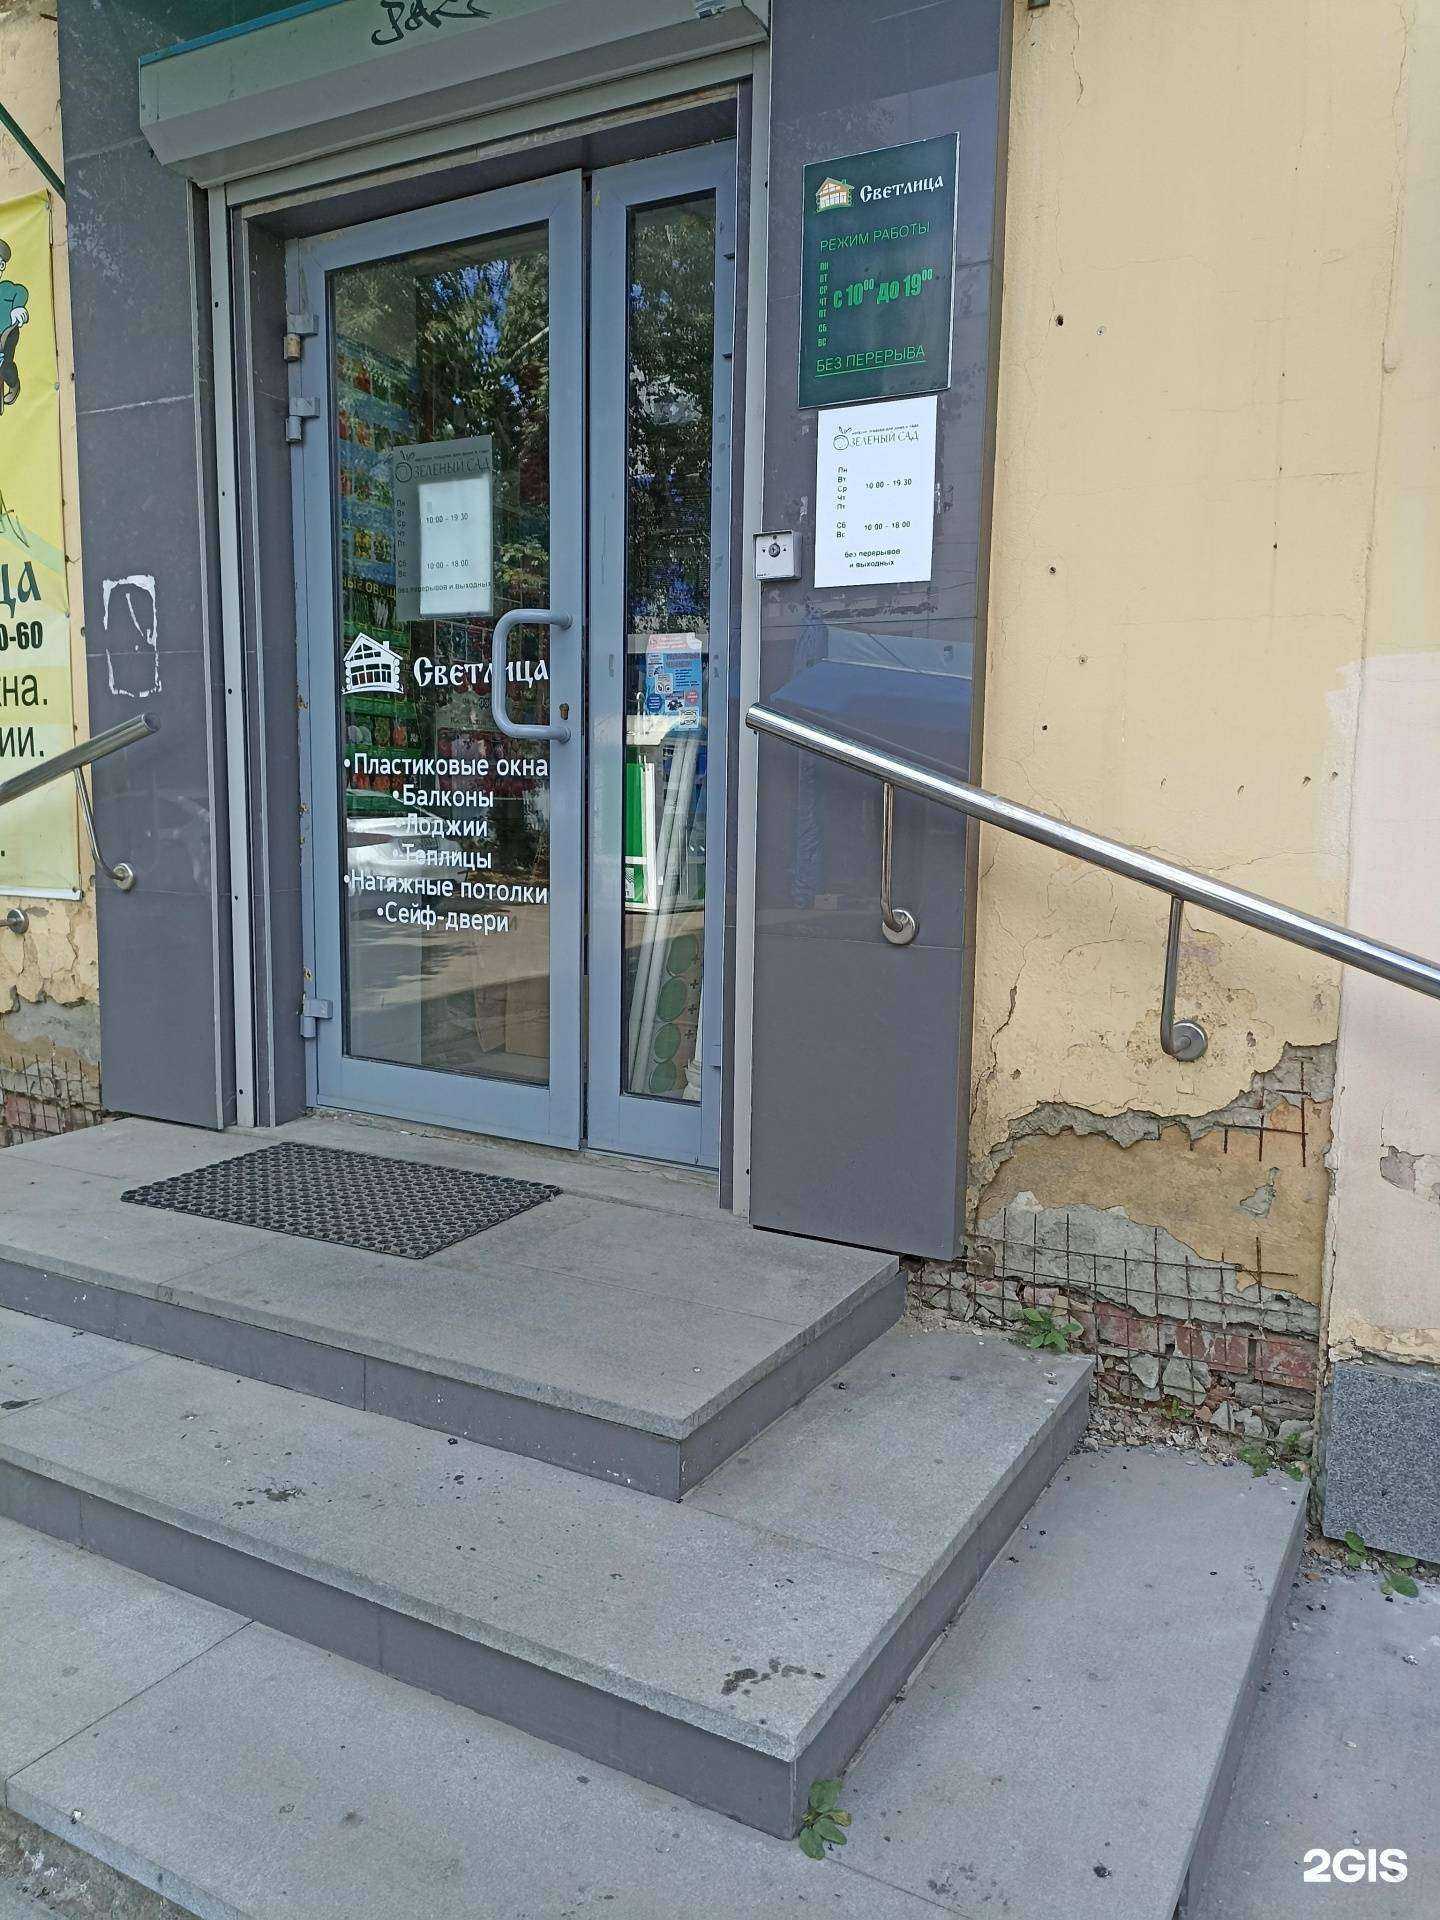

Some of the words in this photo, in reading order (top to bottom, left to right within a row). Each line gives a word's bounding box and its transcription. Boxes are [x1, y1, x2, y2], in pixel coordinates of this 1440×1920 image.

[860, 176, 944, 203] Светлица
[820, 233, 869, 253] РЕЖИМ
[873, 221, 930, 243] РАБОТЫ
[816, 357, 842, 372] БЕЗ
[846, 345, 925, 368] ПЕРЕРЫВА
[851, 433, 896, 447] ЗЕЛЕНЫЙ
[897, 430, 919, 442] САД
[354, 753, 489, 777] Пластиковые
[496, 758, 548, 776] окна
[403, 784, 494, 808] Балконы
[405, 813, 488, 838] Лоджии
[402, 843, 492, 870] Теплицы
[351, 869, 453, 897] Натяжные
[460, 881, 548, 904] потолки
[386, 901, 510, 935] Сейф-двери
